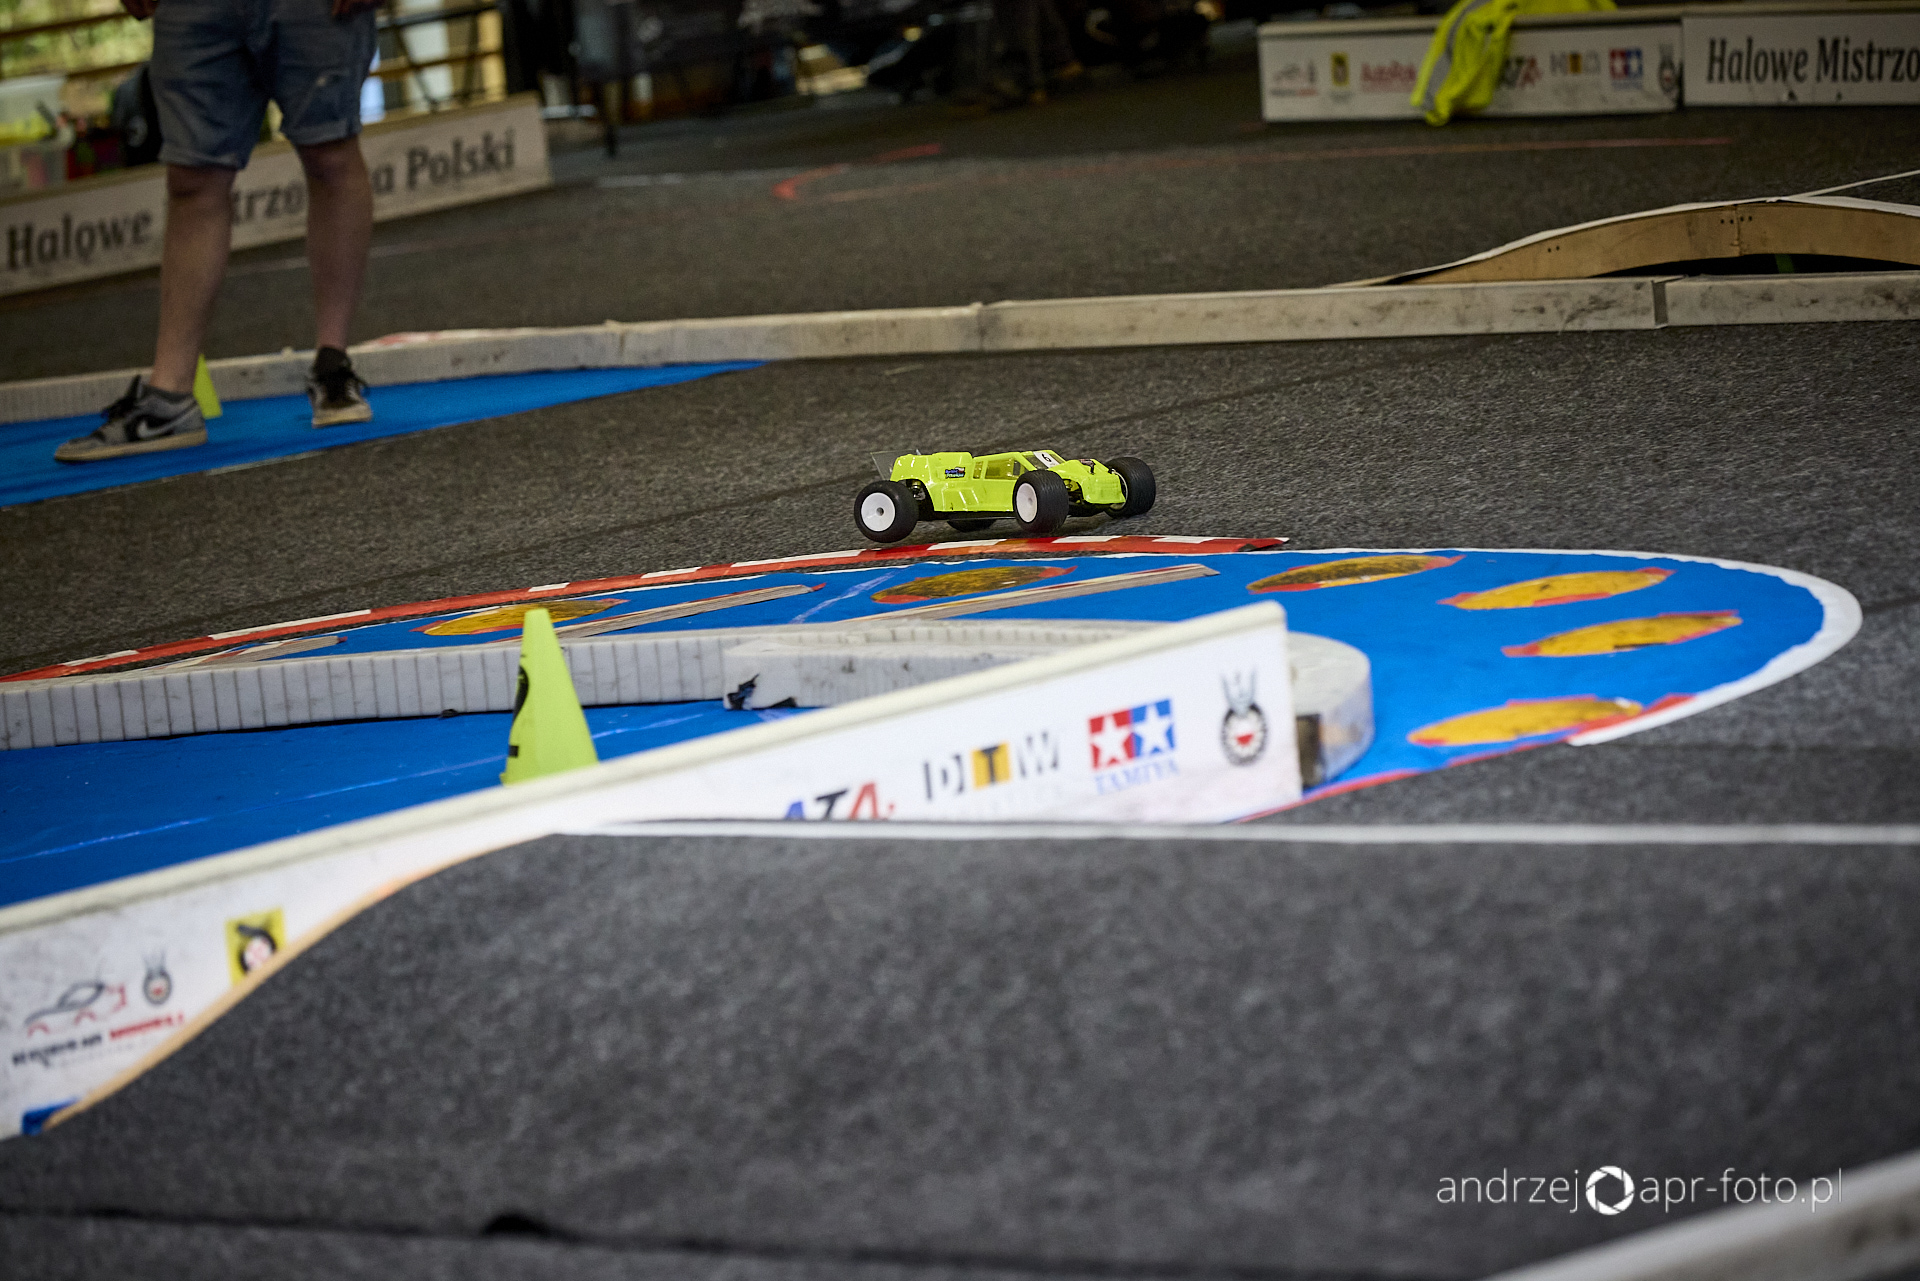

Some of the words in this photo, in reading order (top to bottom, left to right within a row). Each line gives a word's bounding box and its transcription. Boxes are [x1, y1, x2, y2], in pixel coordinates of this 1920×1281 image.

[1707, 36, 1809, 84] Halowe
[5, 209, 154, 270] Halowe
[407, 126, 516, 192] Polski
